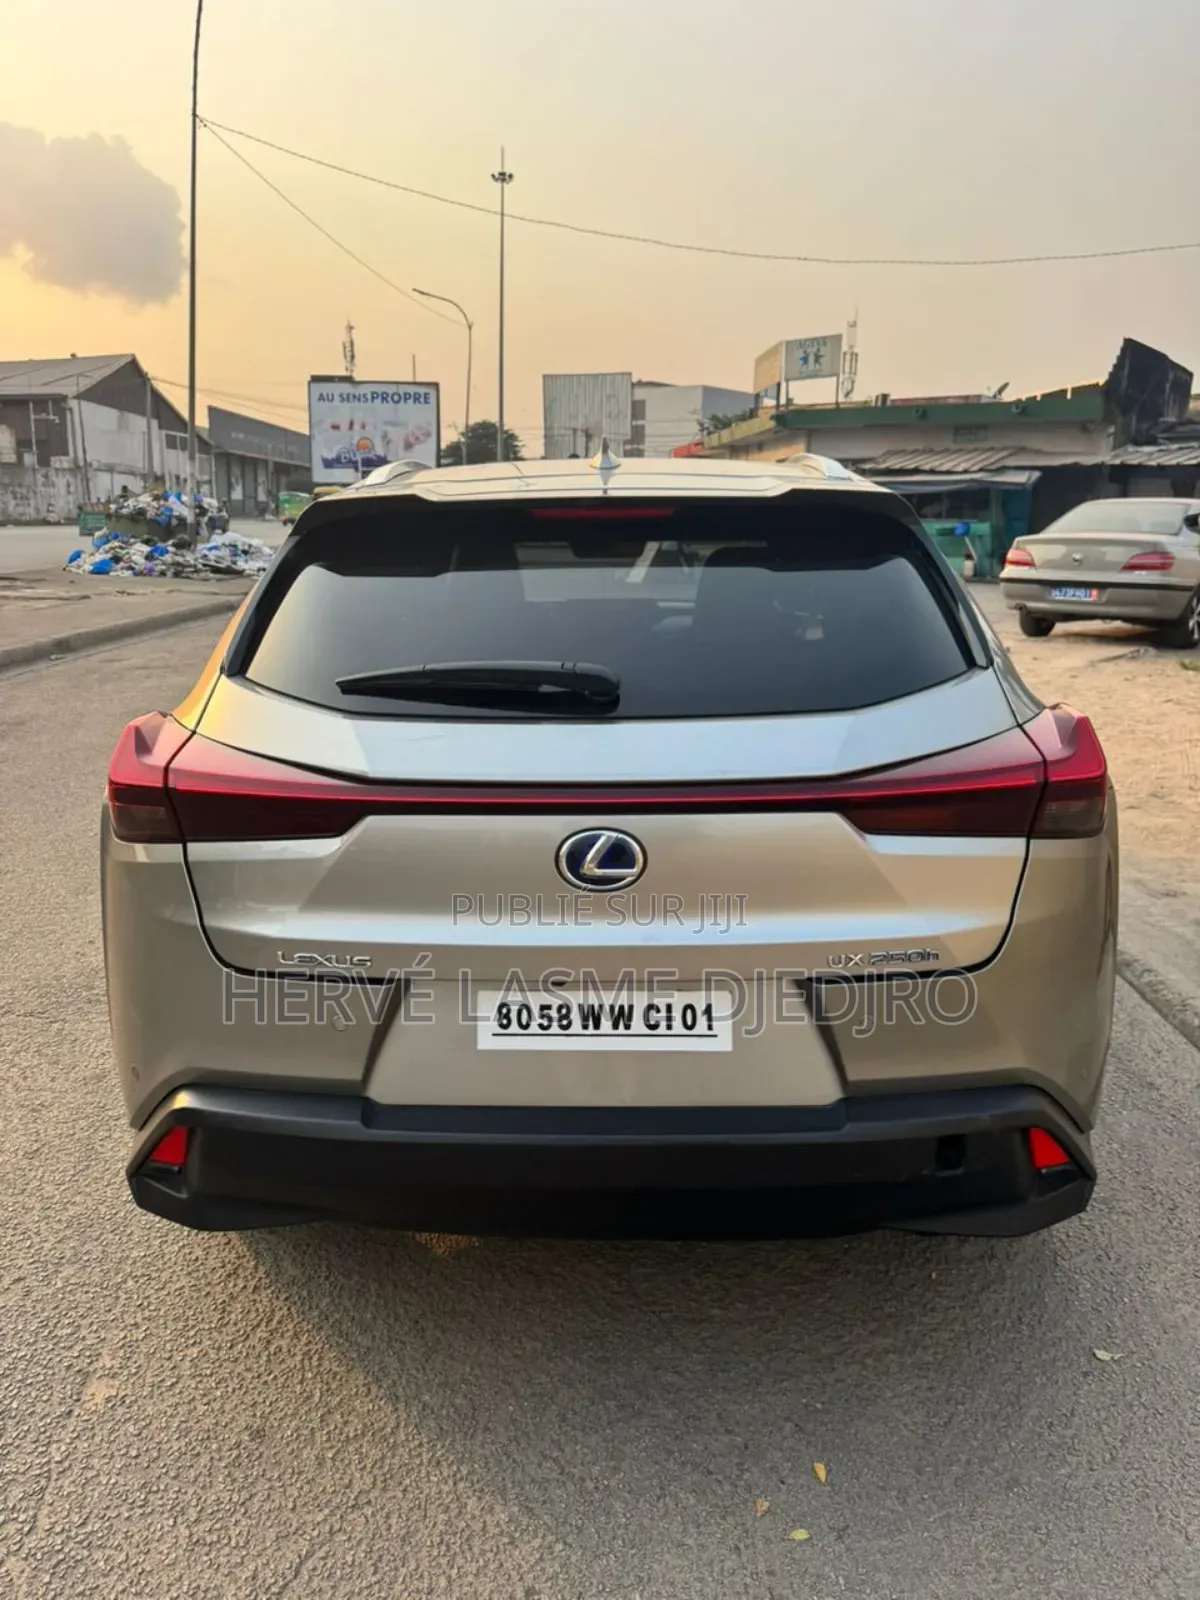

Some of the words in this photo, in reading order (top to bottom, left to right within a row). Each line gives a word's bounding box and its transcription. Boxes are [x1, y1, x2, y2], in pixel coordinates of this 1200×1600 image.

[317, 392, 334, 403] AU
[338, 392, 369, 404] SENS
[370, 391, 431, 405] PROPRE
[277, 950, 373, 969] LEXUS
[827, 953, 864, 969] UX
[868, 948, 940, 966] 250h
[496, 1002, 574, 1031] 8058
